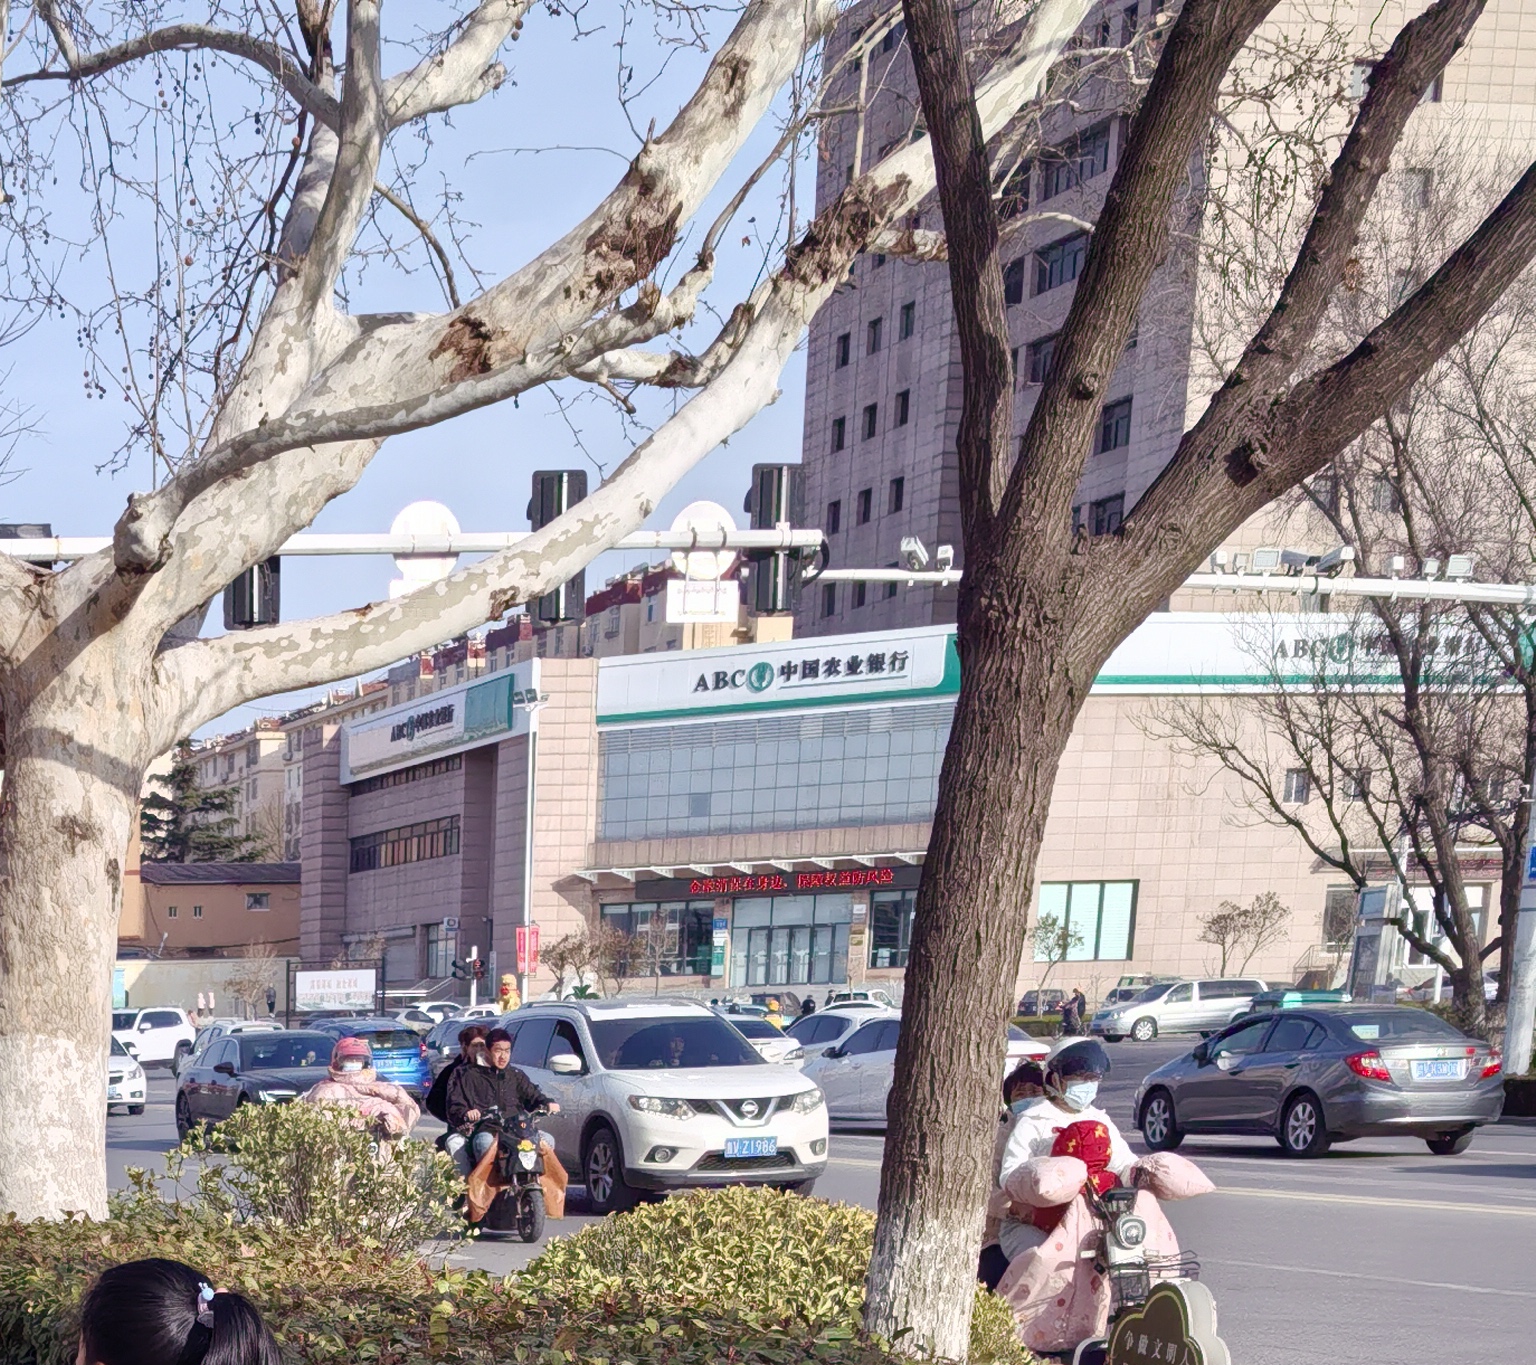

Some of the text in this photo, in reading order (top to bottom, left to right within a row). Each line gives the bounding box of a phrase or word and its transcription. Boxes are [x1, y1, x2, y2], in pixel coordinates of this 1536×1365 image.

[692, 650, 910, 693] ABC 中国农业银行
